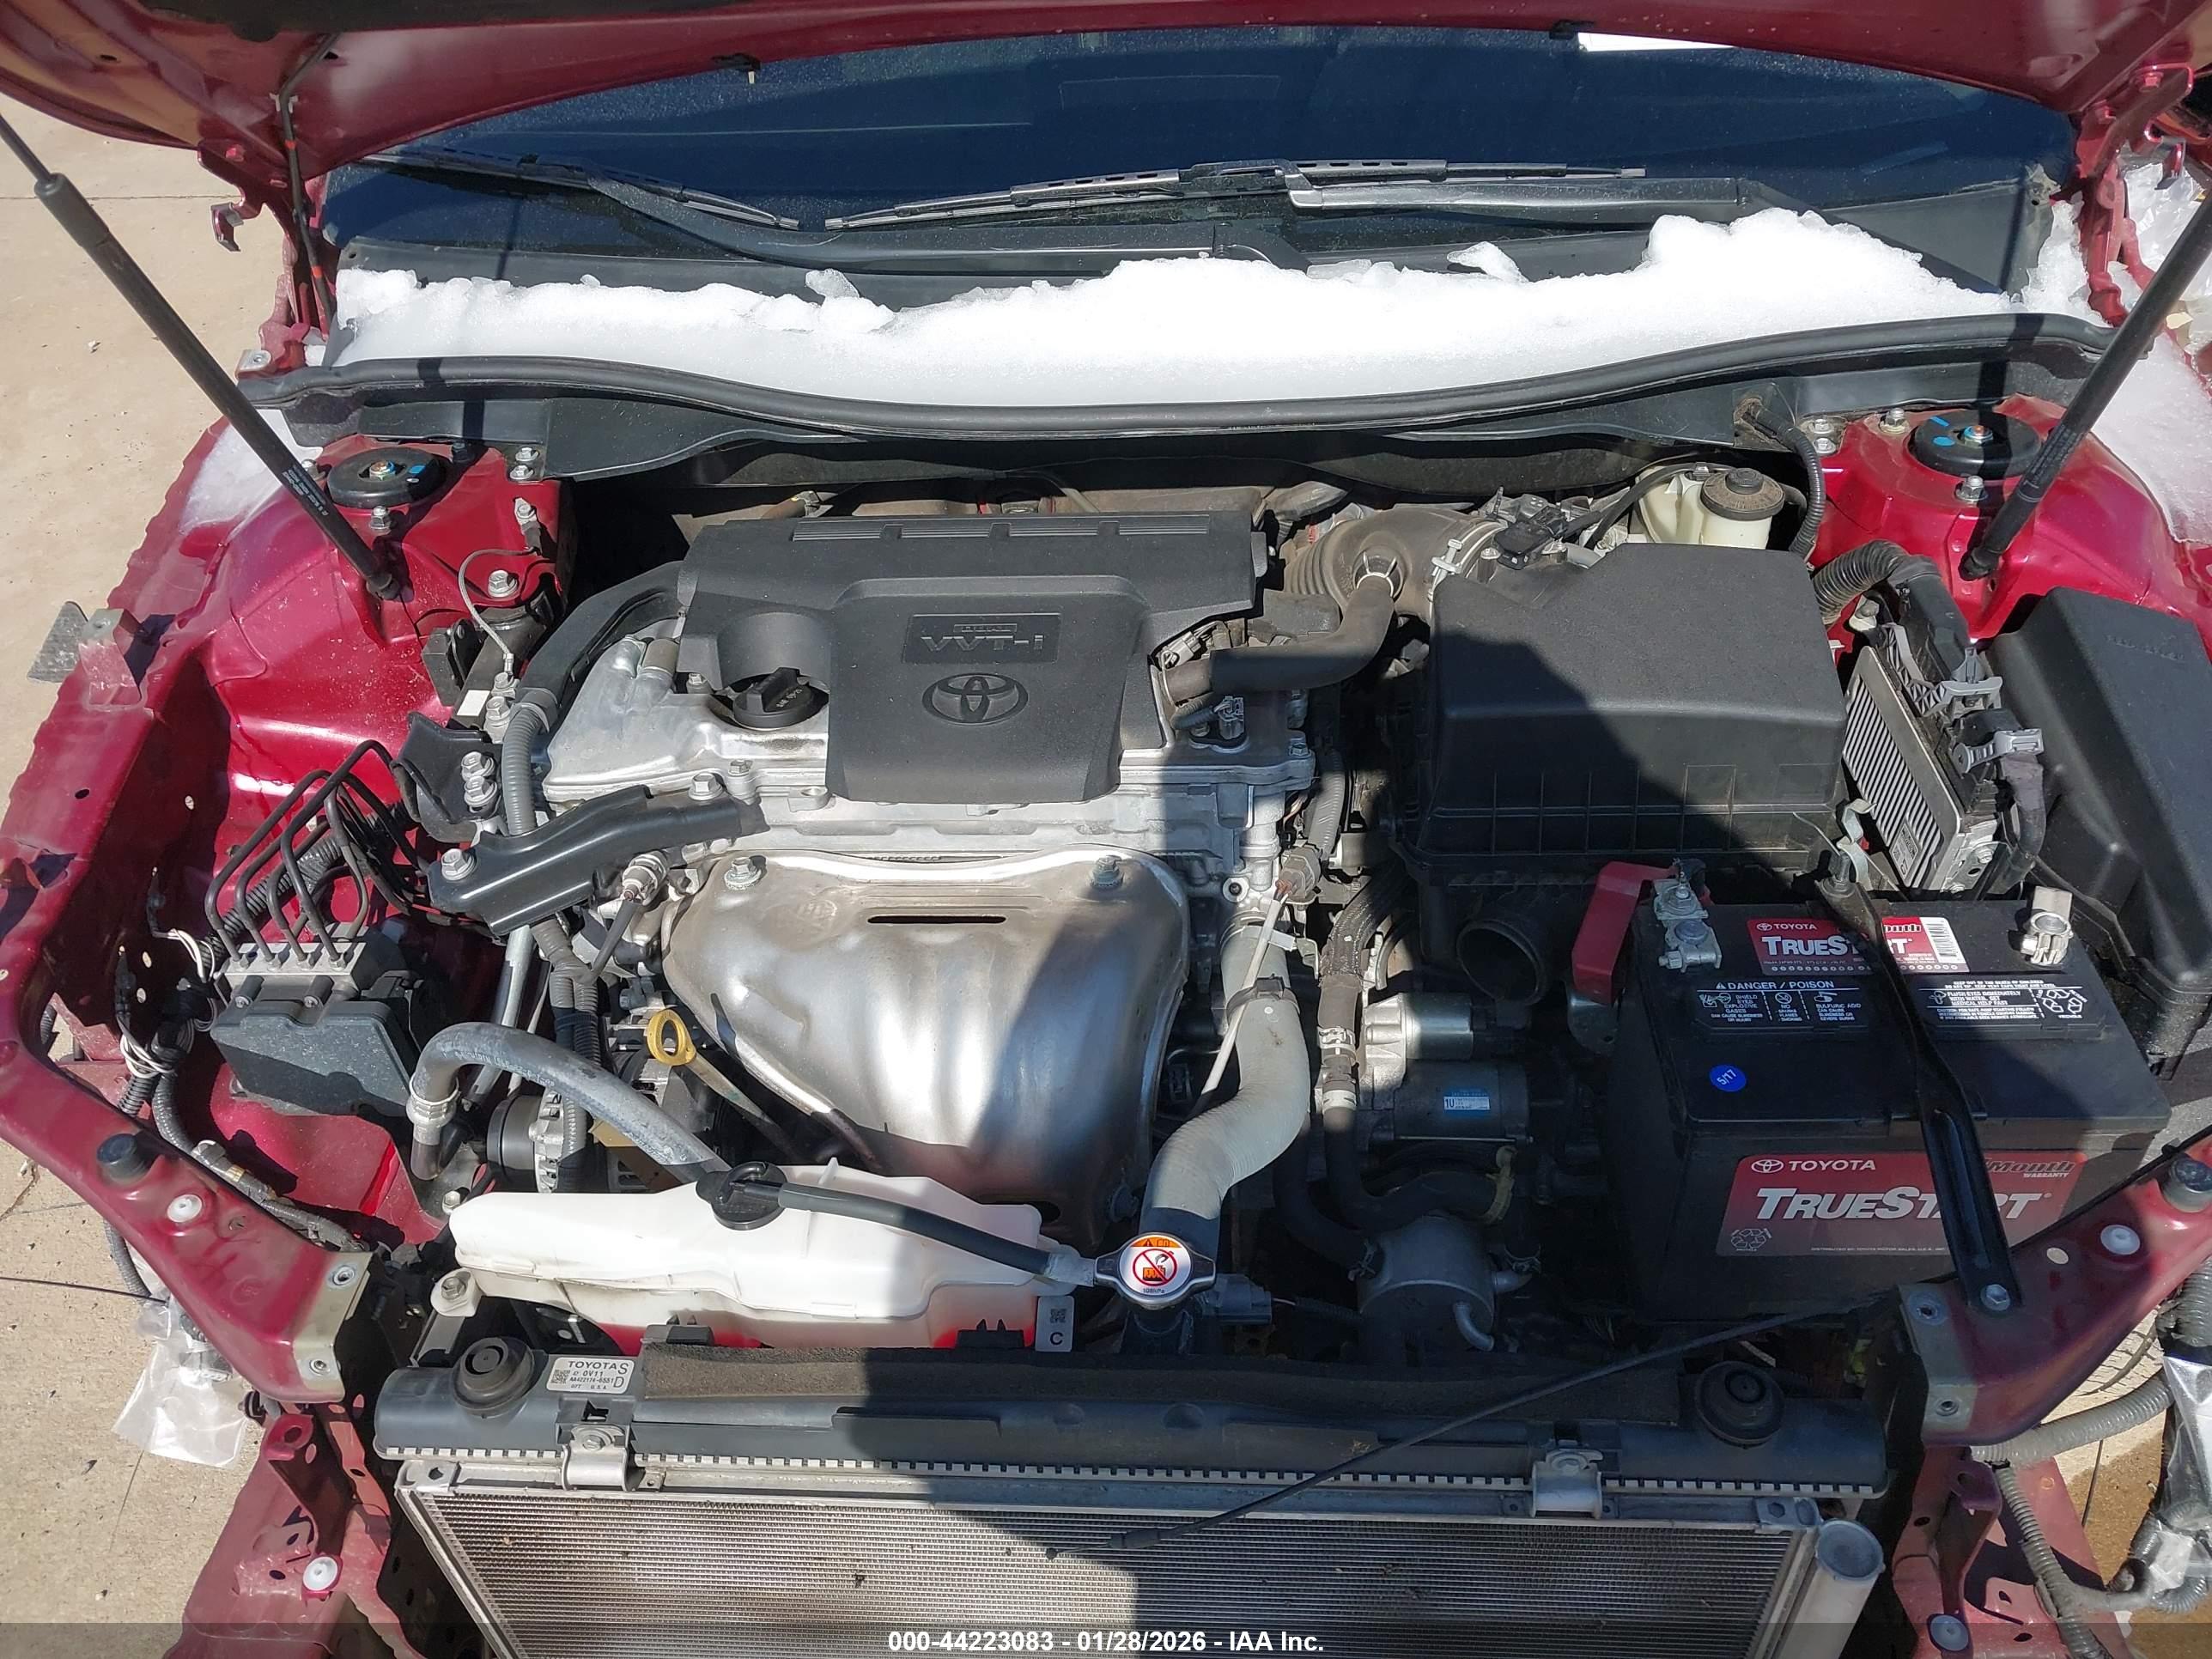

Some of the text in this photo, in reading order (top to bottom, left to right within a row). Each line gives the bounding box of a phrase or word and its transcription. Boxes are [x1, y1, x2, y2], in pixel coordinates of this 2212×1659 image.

[1789, 1160, 1876, 1171] TOYOTA
[1049, 1332, 1063, 1346] C
[568, 1361, 617, 1370] TOYOTA
[617, 1362, 629, 1375] S
[613, 1376, 624, 1388] D
